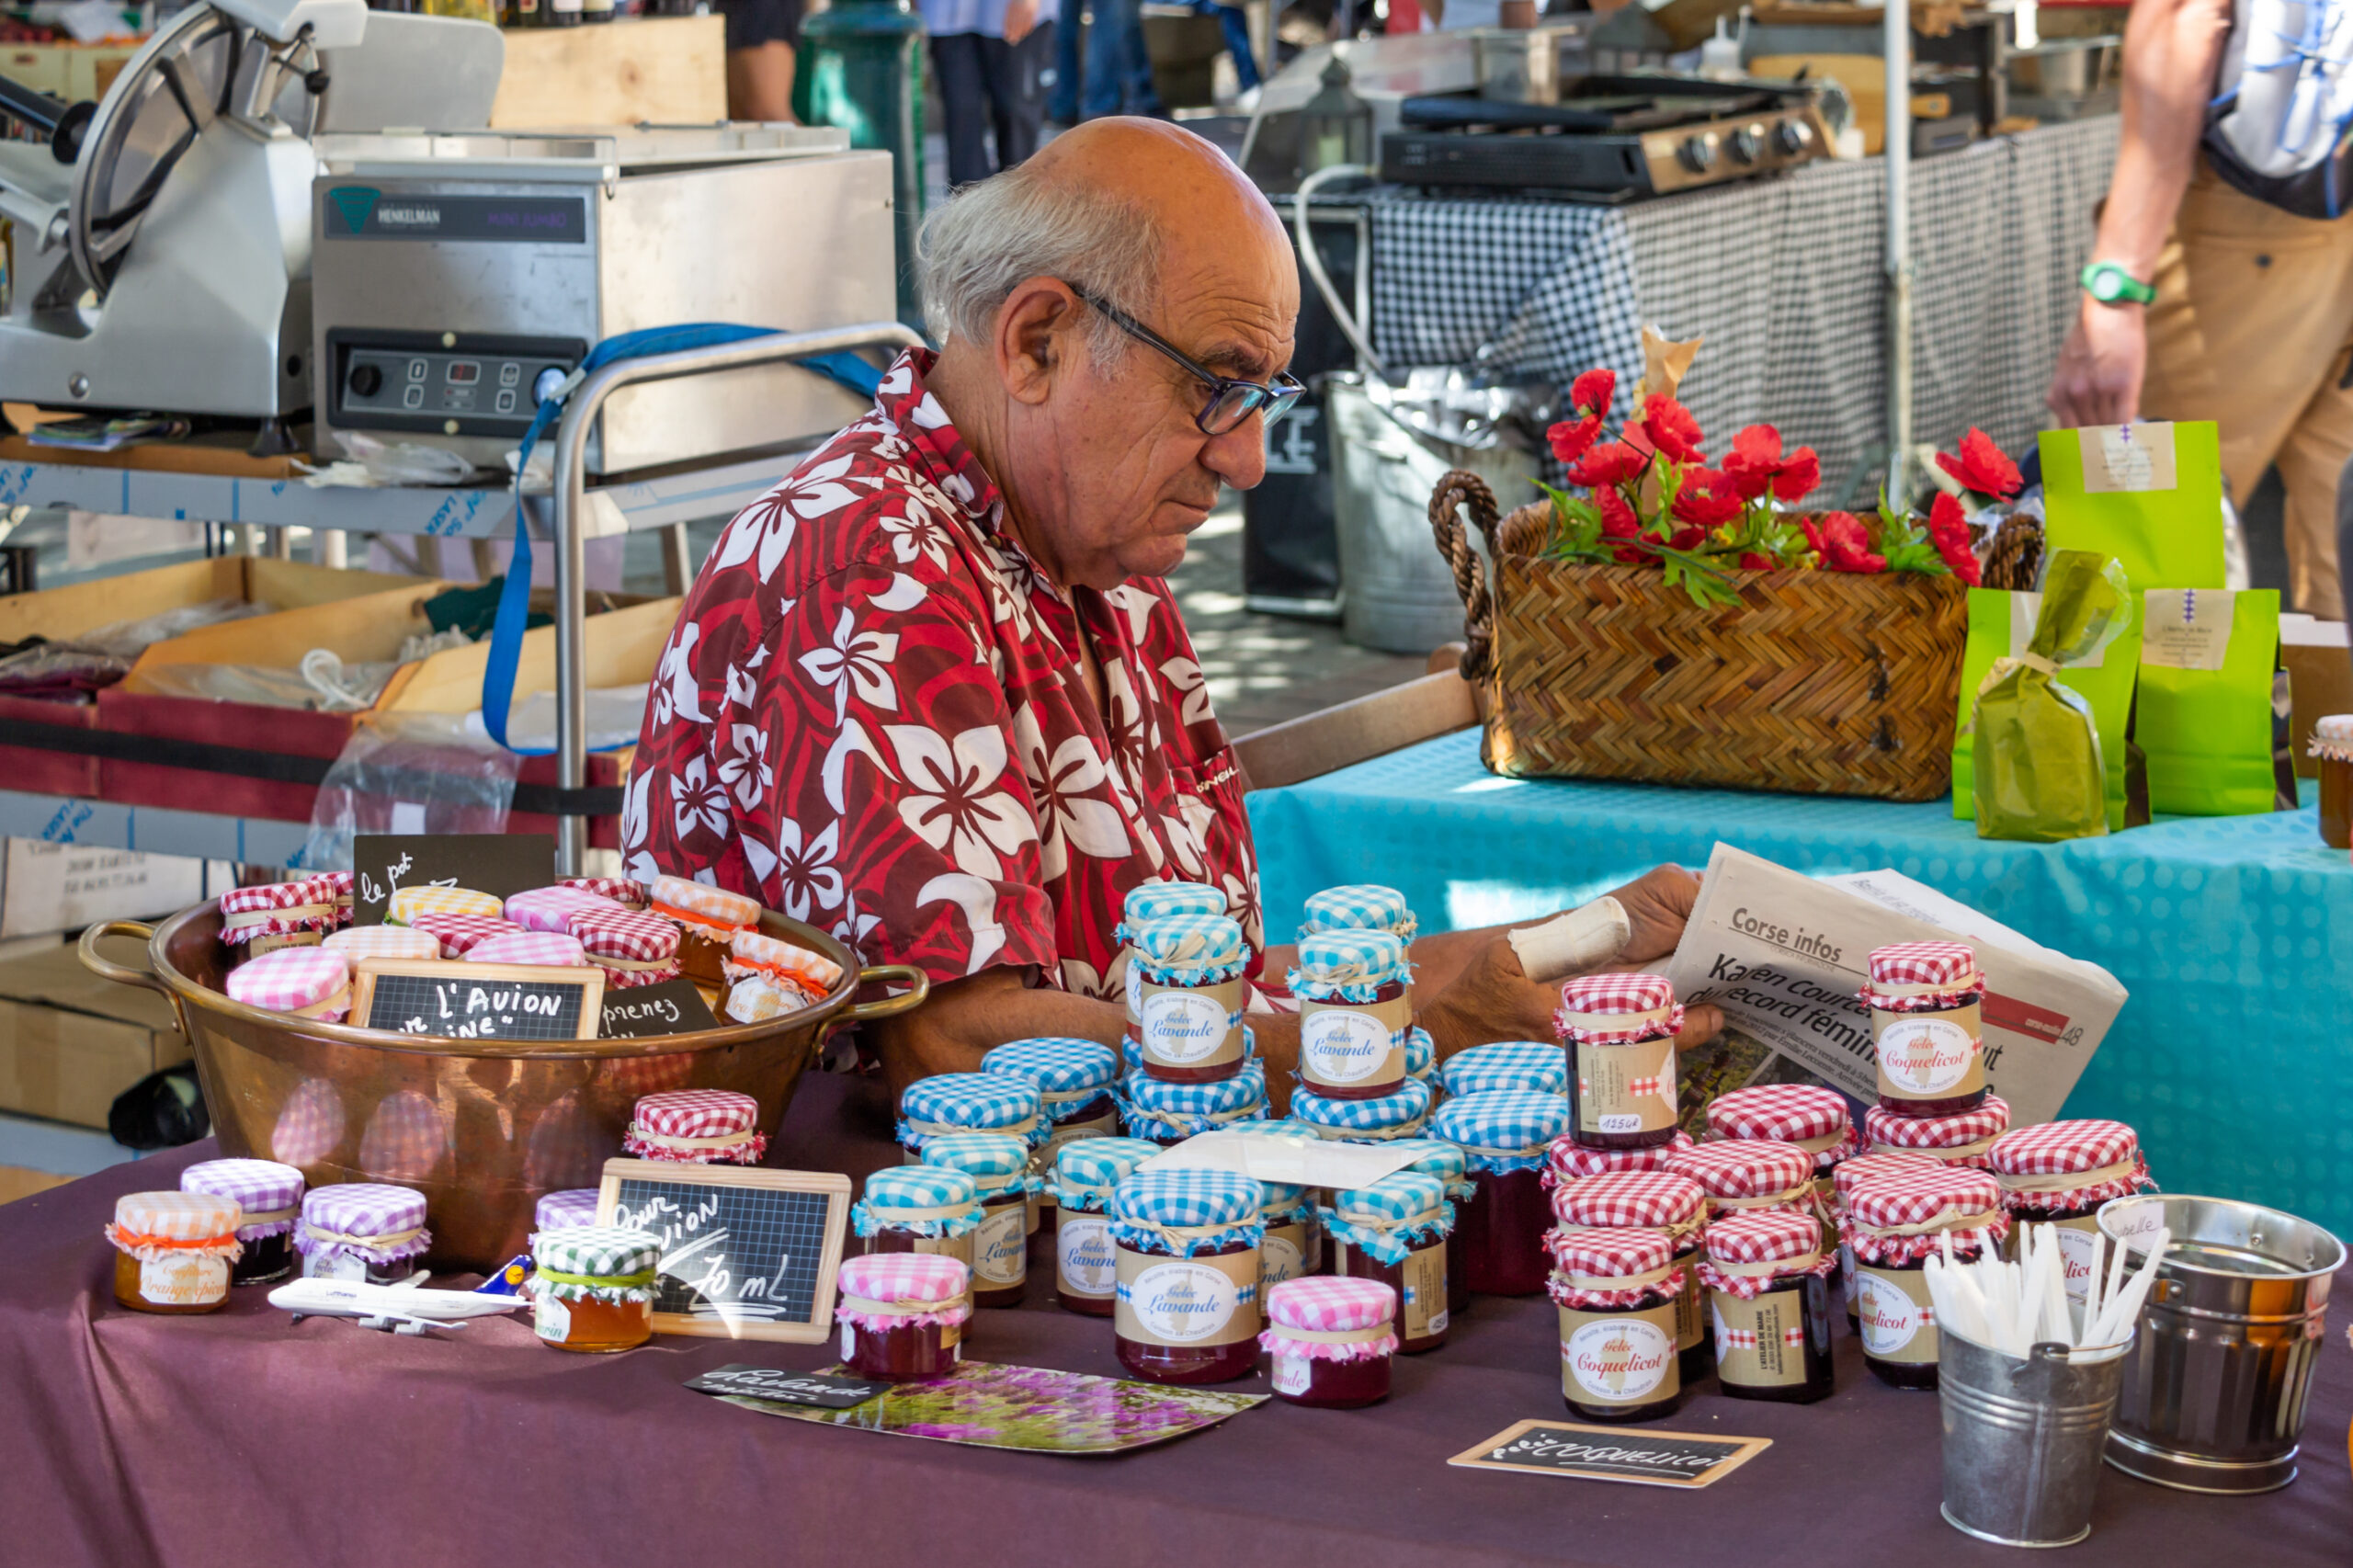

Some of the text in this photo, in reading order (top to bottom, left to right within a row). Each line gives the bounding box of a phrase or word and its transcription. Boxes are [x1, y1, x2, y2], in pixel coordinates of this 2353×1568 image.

[378, 209, 440, 224] HENKELMAN
[361, 852, 413, 903] le pot
[1733, 907, 1842, 962] Corse infos
[1708, 953, 1788, 987] Karen
[602, 998, 680, 1034] prenez
[1149, 1018, 1213, 1037] Lavande
[1717, 987, 1808, 1019] record
[1801, 1009, 1876, 1066] fémin
[1310, 1037, 1375, 1056] Lavande
[2061, 1027, 2084, 1046] 48
[1885, 1050, 1964, 1075] Coquelicot
[613, 1197, 679, 1230] Pour
[1142, 1293, 1220, 1314] Lavande
[1757, 1331, 1765, 1341] DE
[1577, 1352, 1662, 1381] Coquelicot
[1758, 1341, 1768, 1369] L'ATELIER
